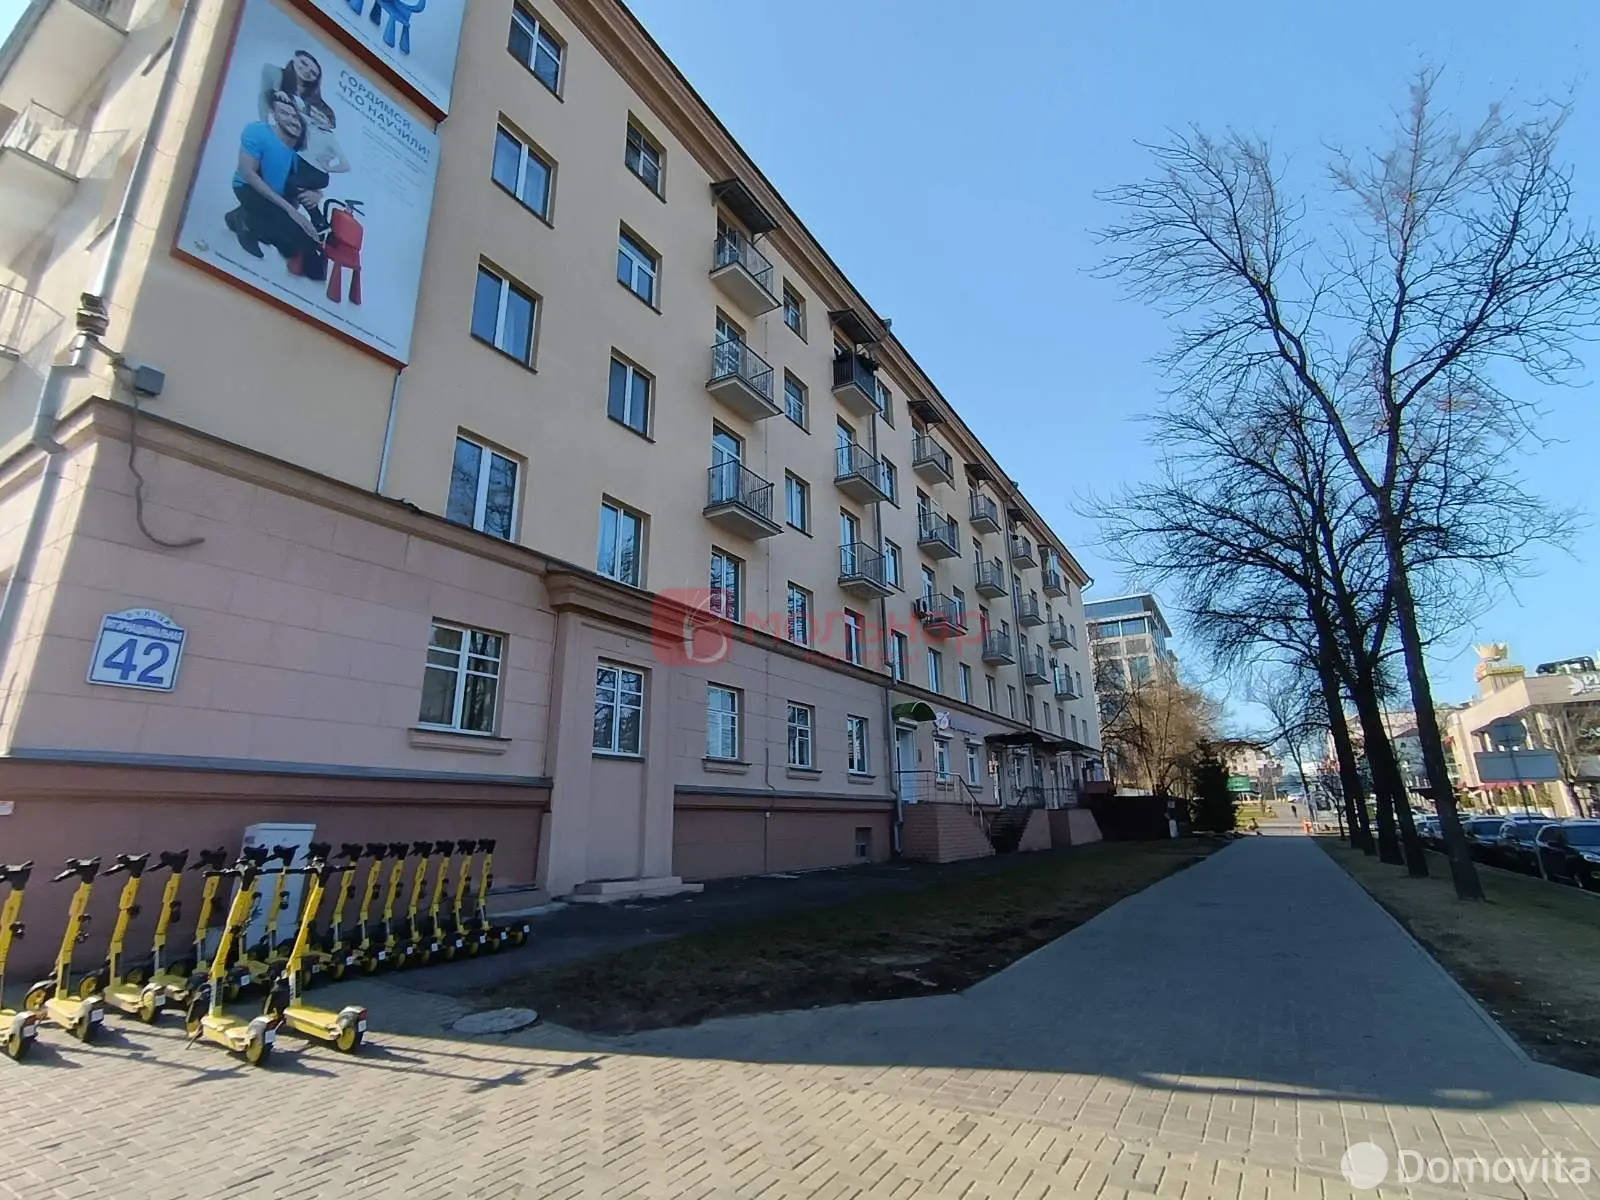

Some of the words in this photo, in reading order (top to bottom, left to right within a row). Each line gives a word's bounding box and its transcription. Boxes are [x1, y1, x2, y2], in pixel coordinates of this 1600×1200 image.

[338, 80, 365, 106] ЧТО
[367, 104, 431, 158] НАУЧИЛИ!
[103, 638, 170, 685] 42
